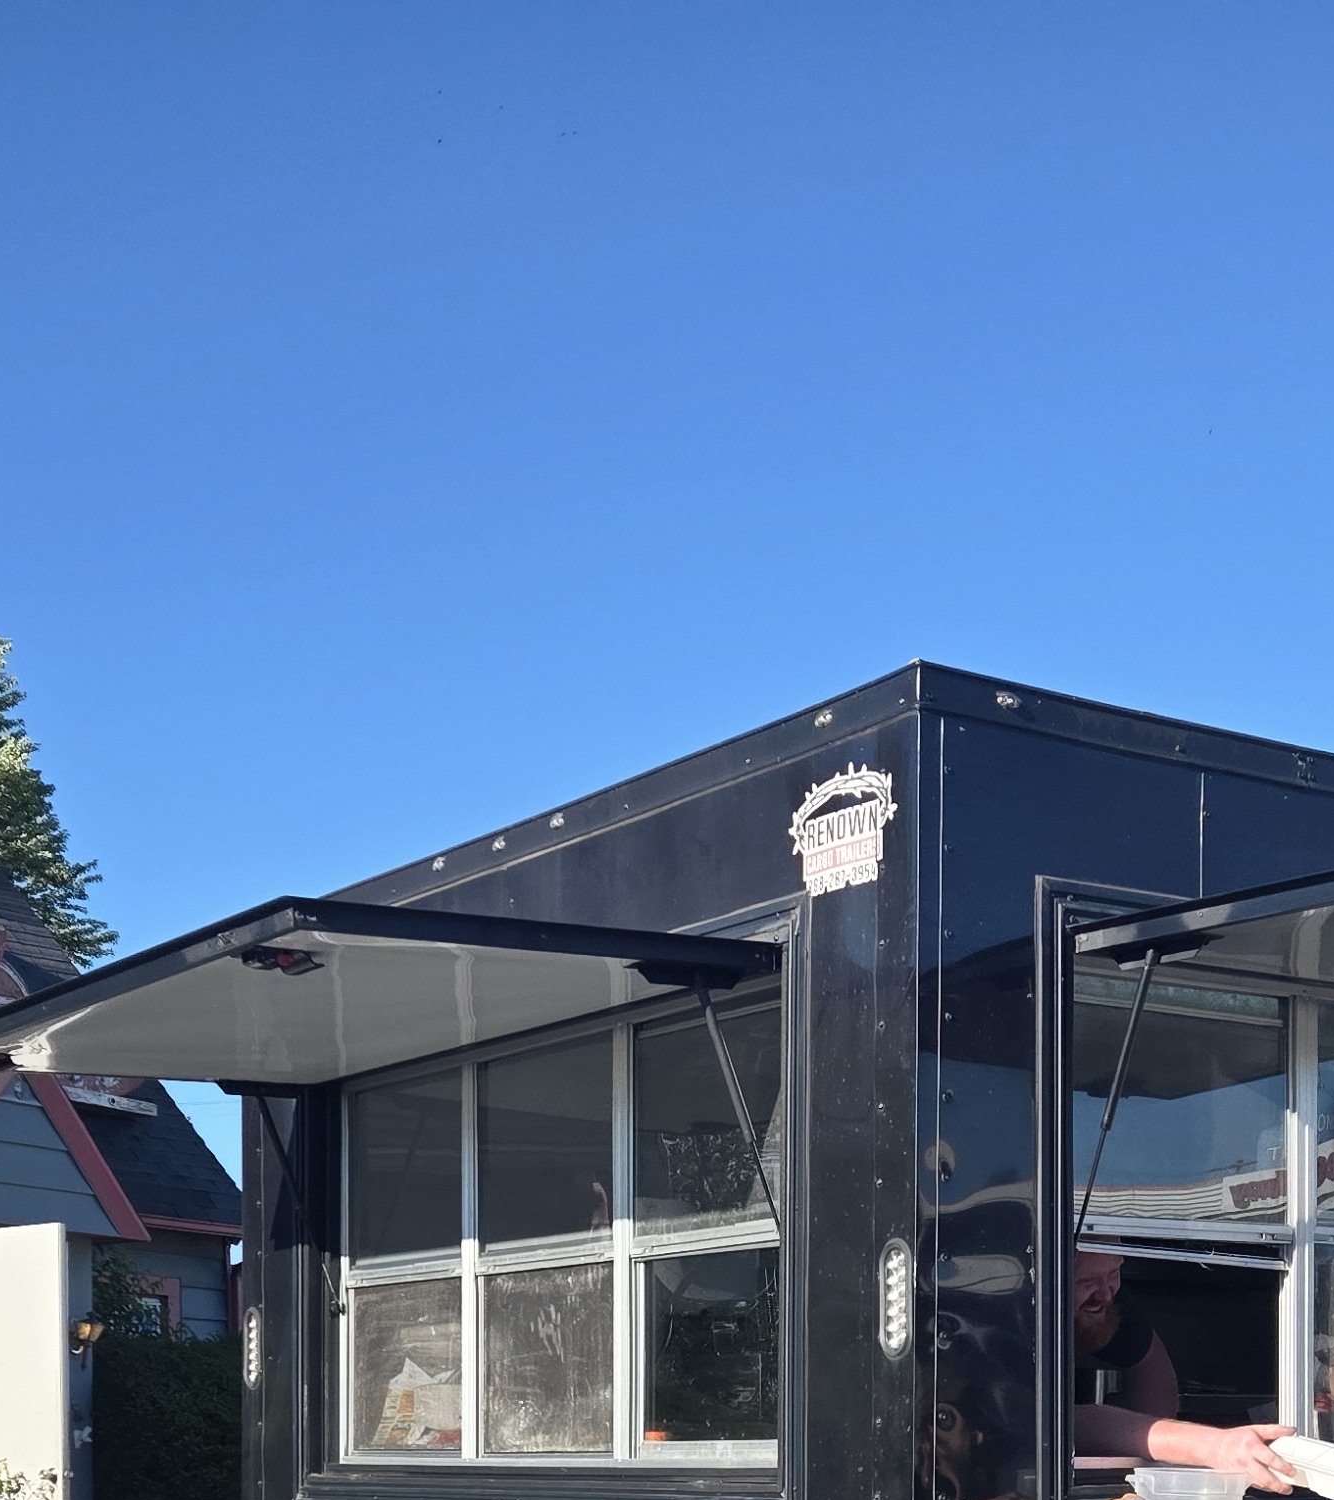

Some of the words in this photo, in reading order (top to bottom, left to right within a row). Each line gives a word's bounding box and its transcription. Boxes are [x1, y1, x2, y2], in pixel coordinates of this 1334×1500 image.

[807, 803, 878, 850] RENOWN
[806, 852, 834, 875] CARGO
[836, 837, 880, 866] TRAILERS
